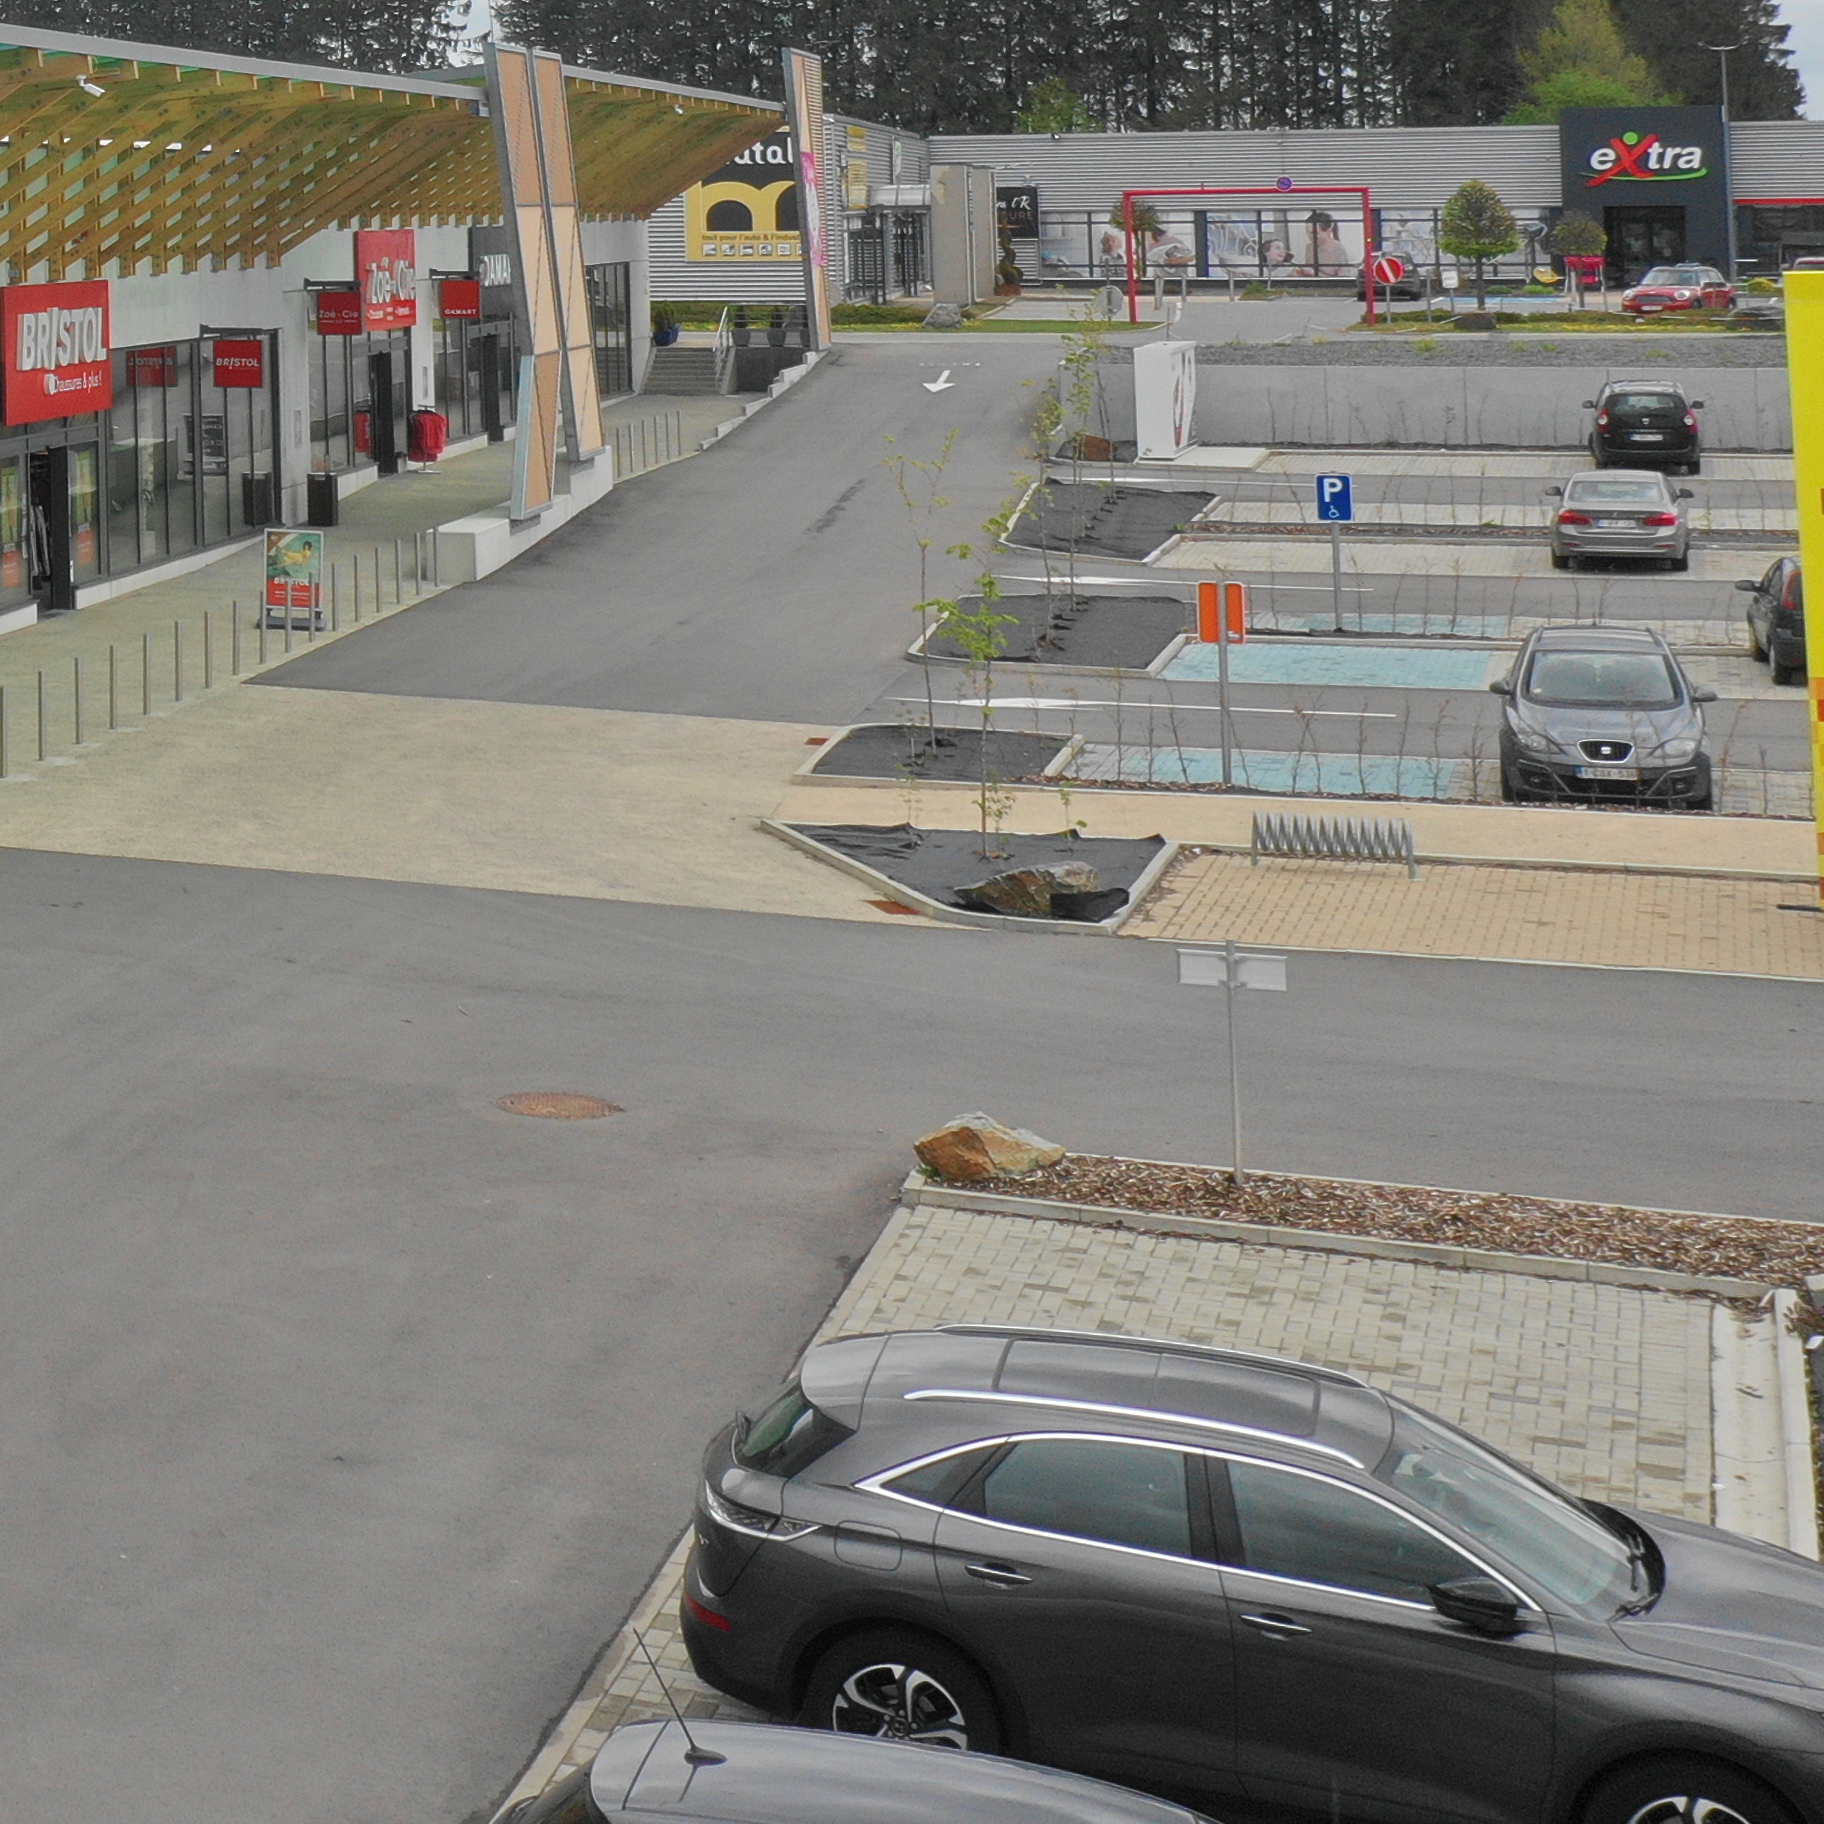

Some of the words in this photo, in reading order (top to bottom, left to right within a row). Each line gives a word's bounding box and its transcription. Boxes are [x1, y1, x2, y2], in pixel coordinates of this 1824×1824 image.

[17, 307, 107, 370] BRISTOL
[216, 358, 259, 369] BRISTOL
[1323, 478, 1342, 503] P
